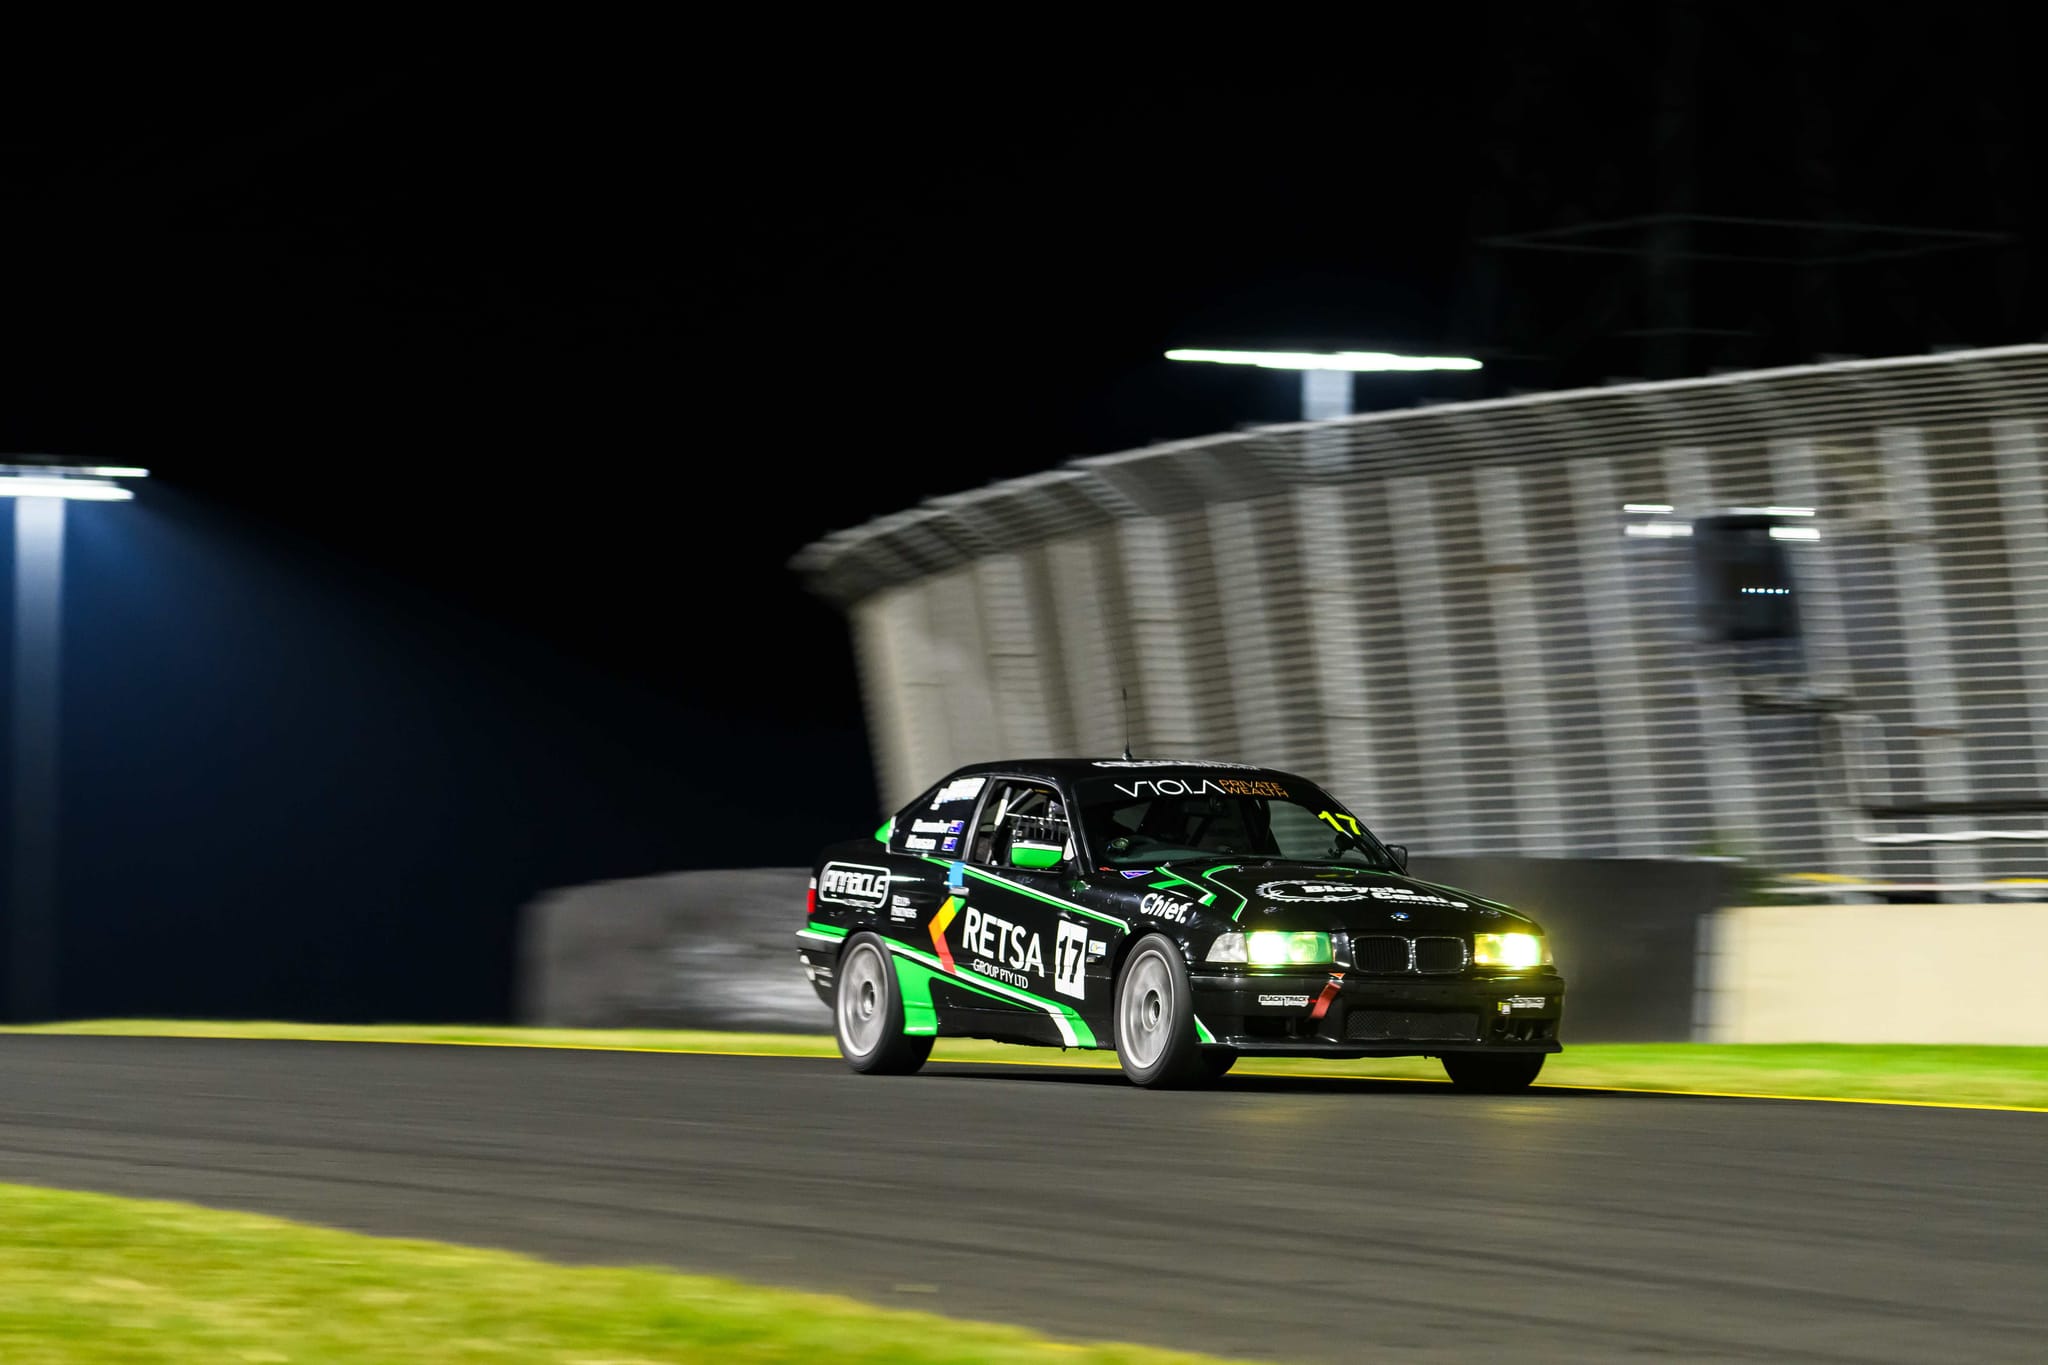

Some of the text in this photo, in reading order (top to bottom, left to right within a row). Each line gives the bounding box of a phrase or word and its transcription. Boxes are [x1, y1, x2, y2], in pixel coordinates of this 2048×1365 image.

[1114, 779, 1226, 798] VIOLA
[1218, 779, 1283, 791] PRIVATE
[1224, 786, 1289, 798] WEALTH
[1318, 810, 1362, 836] 17
[962, 906, 1045, 978] RETSA
[1057, 935, 1084, 984] 17
[973, 958, 1029, 989] GROUP PTY LTD
